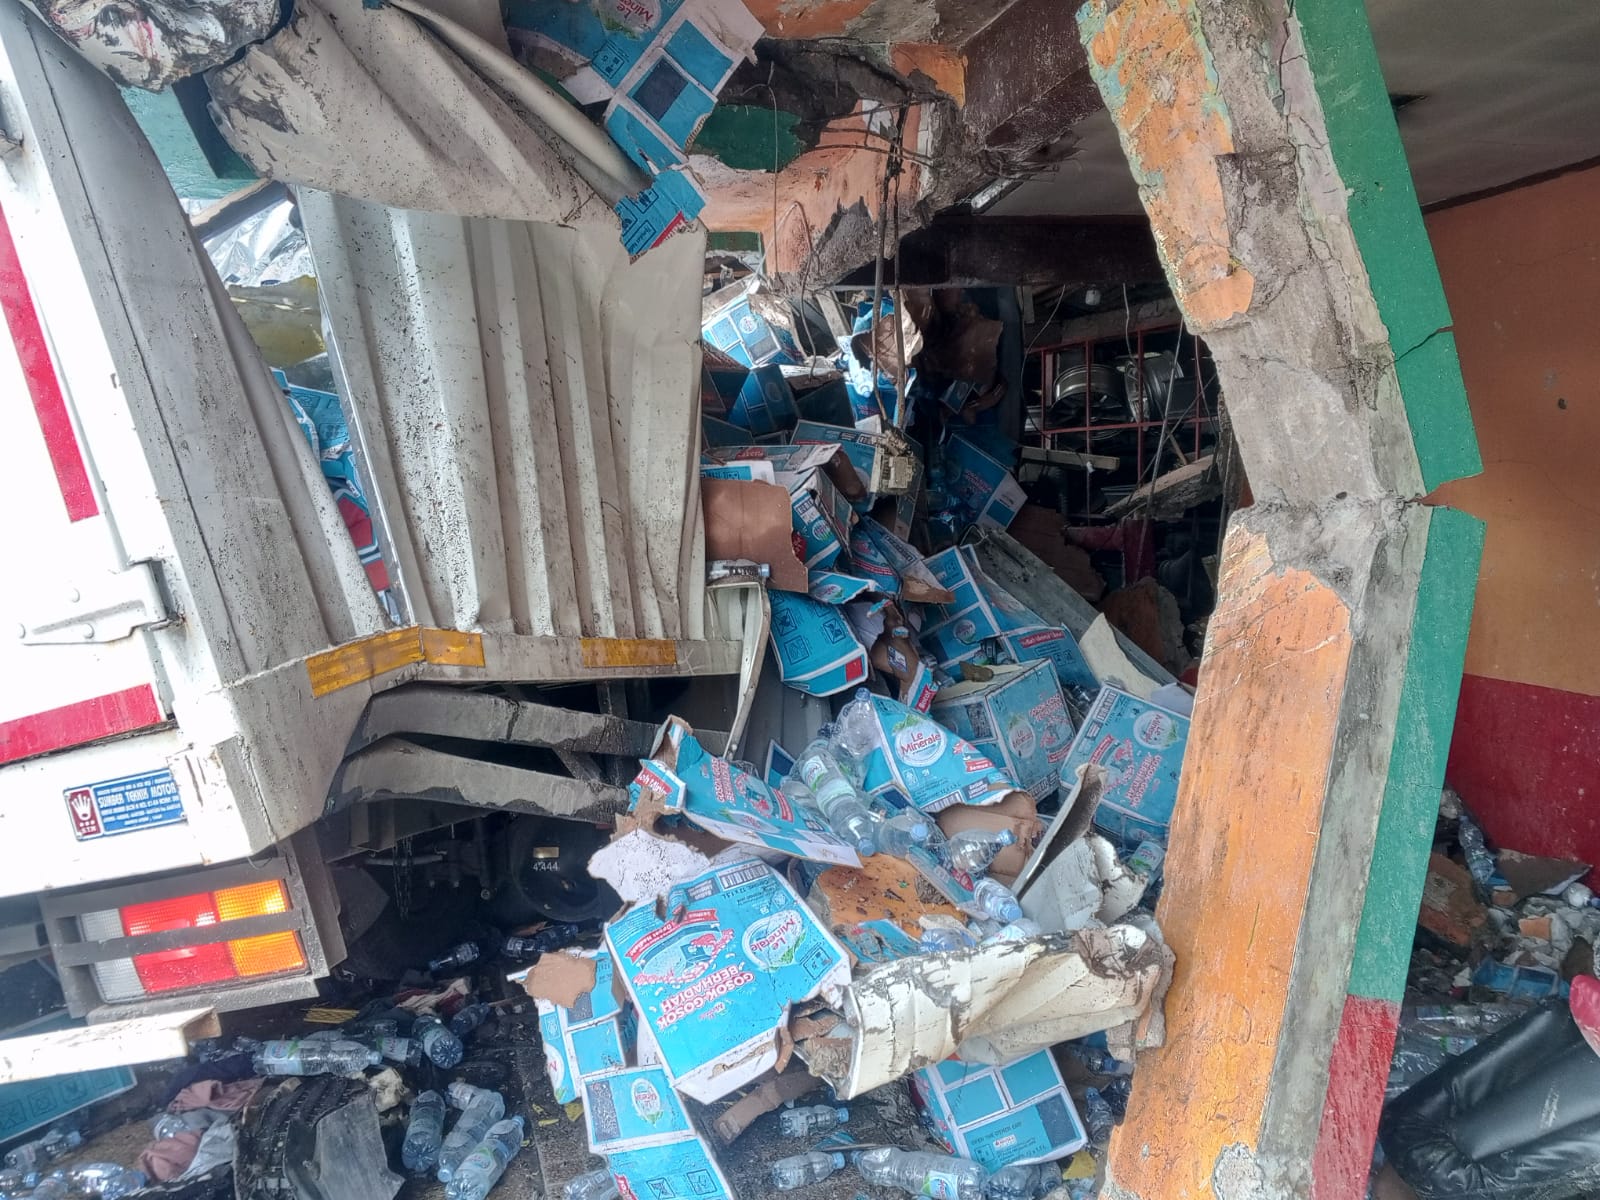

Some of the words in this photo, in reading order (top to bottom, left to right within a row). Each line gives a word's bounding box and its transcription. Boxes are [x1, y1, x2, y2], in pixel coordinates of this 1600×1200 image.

[901, 733, 941, 753] Minerale
[912, 731, 924, 742] Le
[150, 782, 176, 797] MOTOR
[751, 918, 795, 952] Minerale
[769, 935, 786, 951] Le
[660, 964, 741, 1011] BERHADIAH
[657, 972, 754, 1030] GOSOK-GOSOK
